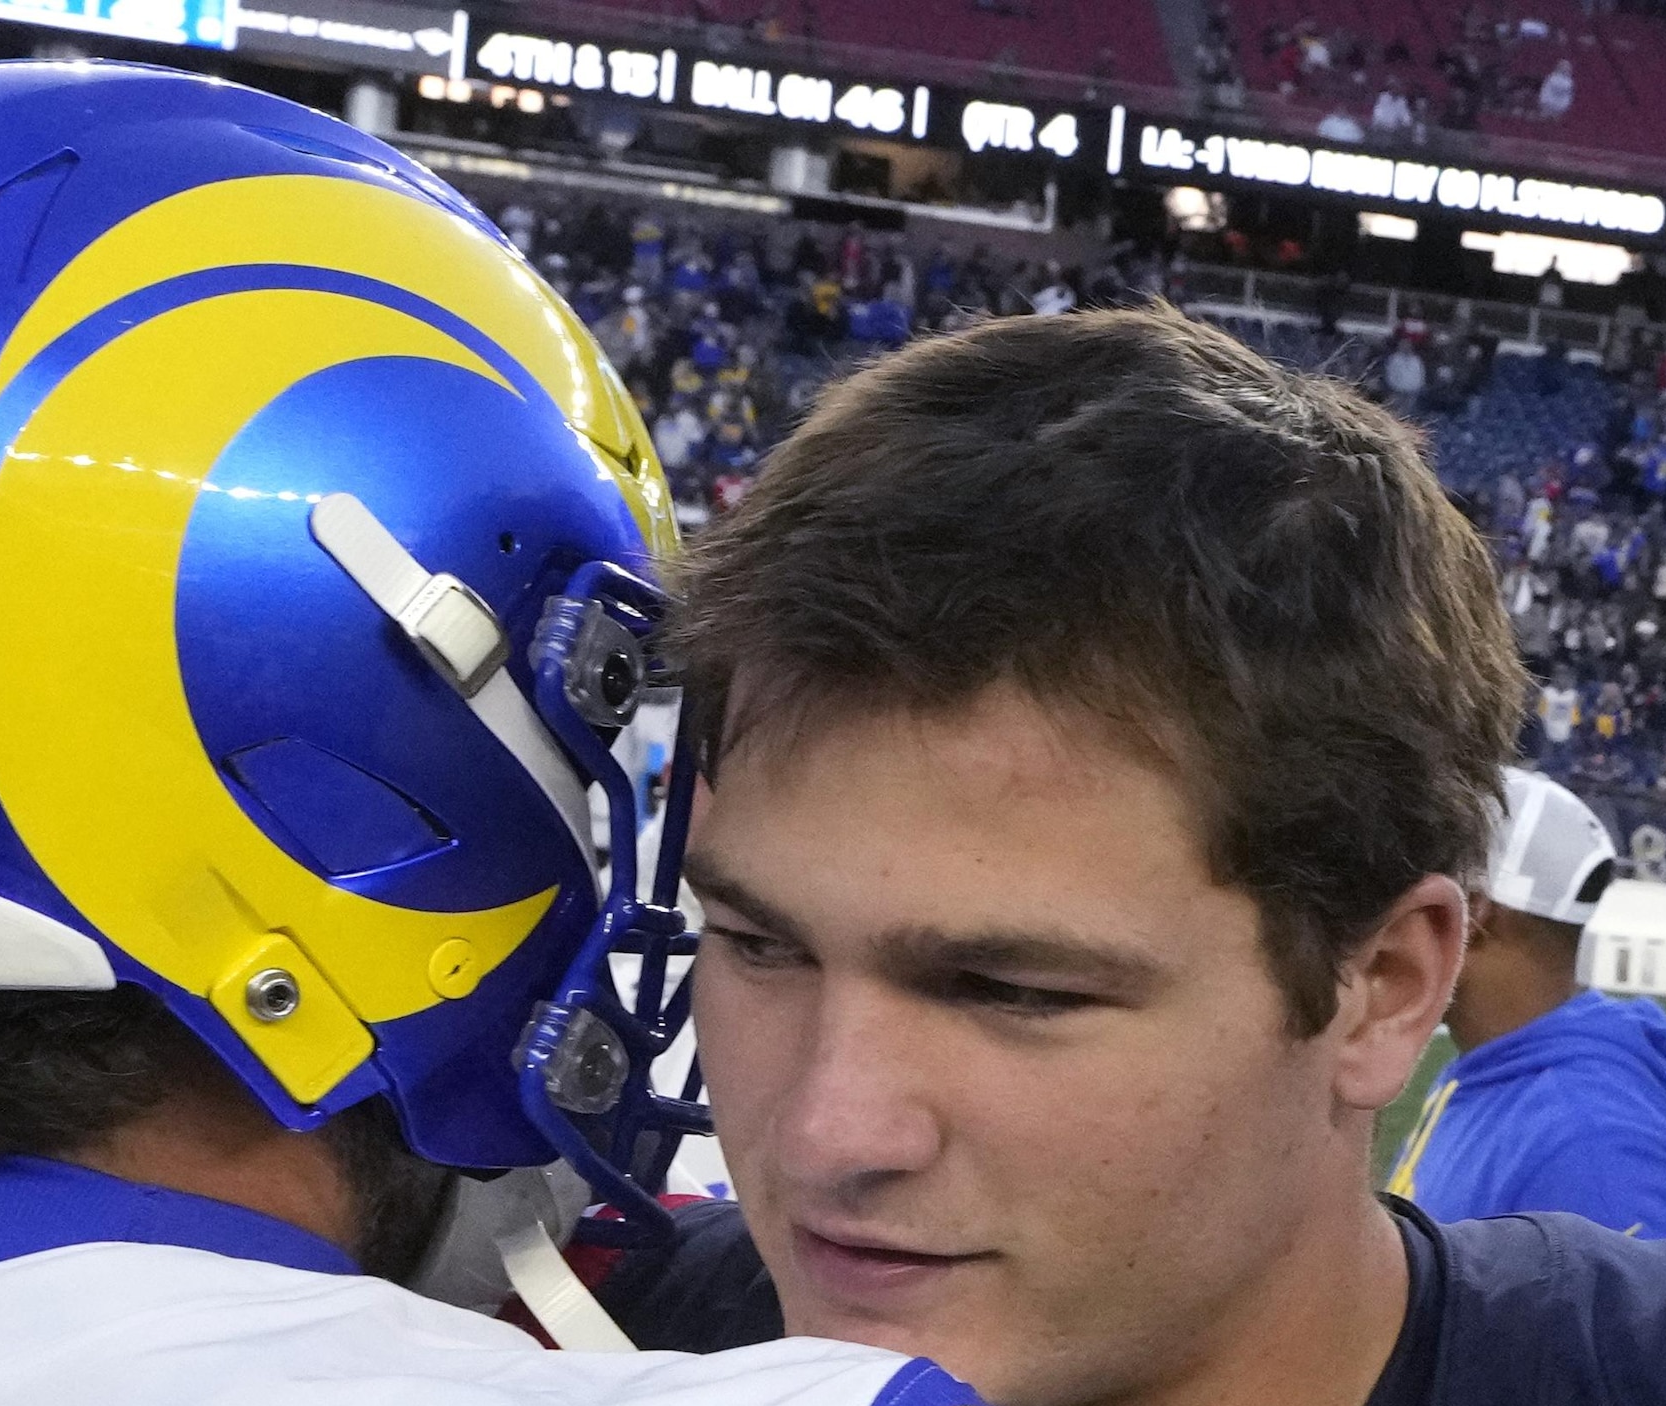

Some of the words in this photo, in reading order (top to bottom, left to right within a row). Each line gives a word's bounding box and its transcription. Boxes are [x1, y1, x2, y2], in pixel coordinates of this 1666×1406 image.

[476, 32, 573, 85] 4TH
[961, 99, 1035, 152] QTR
[1039, 112, 1079, 157] 4
